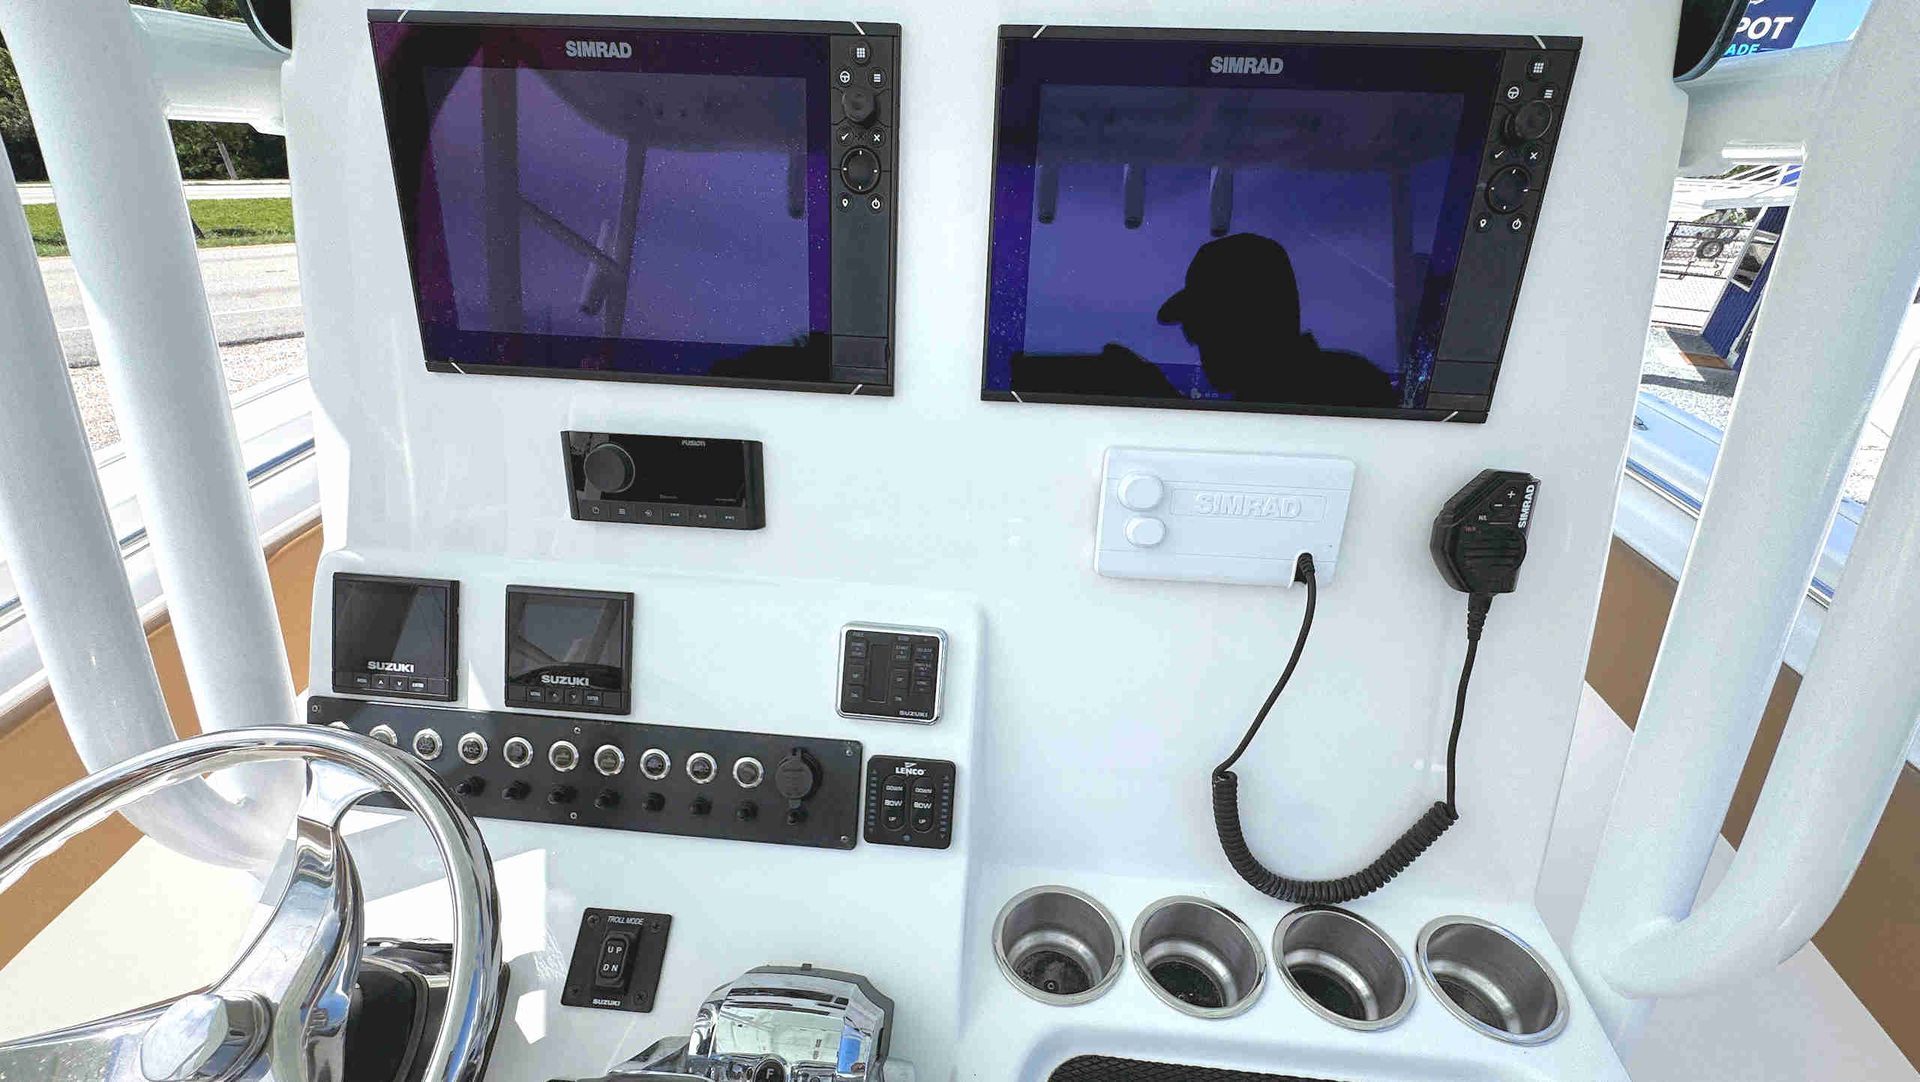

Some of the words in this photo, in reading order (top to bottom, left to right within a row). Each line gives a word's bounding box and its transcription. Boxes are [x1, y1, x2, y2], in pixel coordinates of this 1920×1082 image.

[565, 40, 632, 59] SIMRAD
[1210, 56, 1284, 75] SIMRAD
[1194, 492, 1302, 519] SIMRAD
[1517, 484, 1535, 529] SIMRAD
[367, 661, 415, 673] SUZUKI
[541, 674, 590, 687] SUZUKI
[899, 710, 928, 718] SUZUKI
[895, 766, 925, 776] LENCO
[884, 799, 903, 807] BOW
[913, 801, 932, 809] BOW
[607, 946, 622, 954] UP
[602, 963, 619, 972] DN
